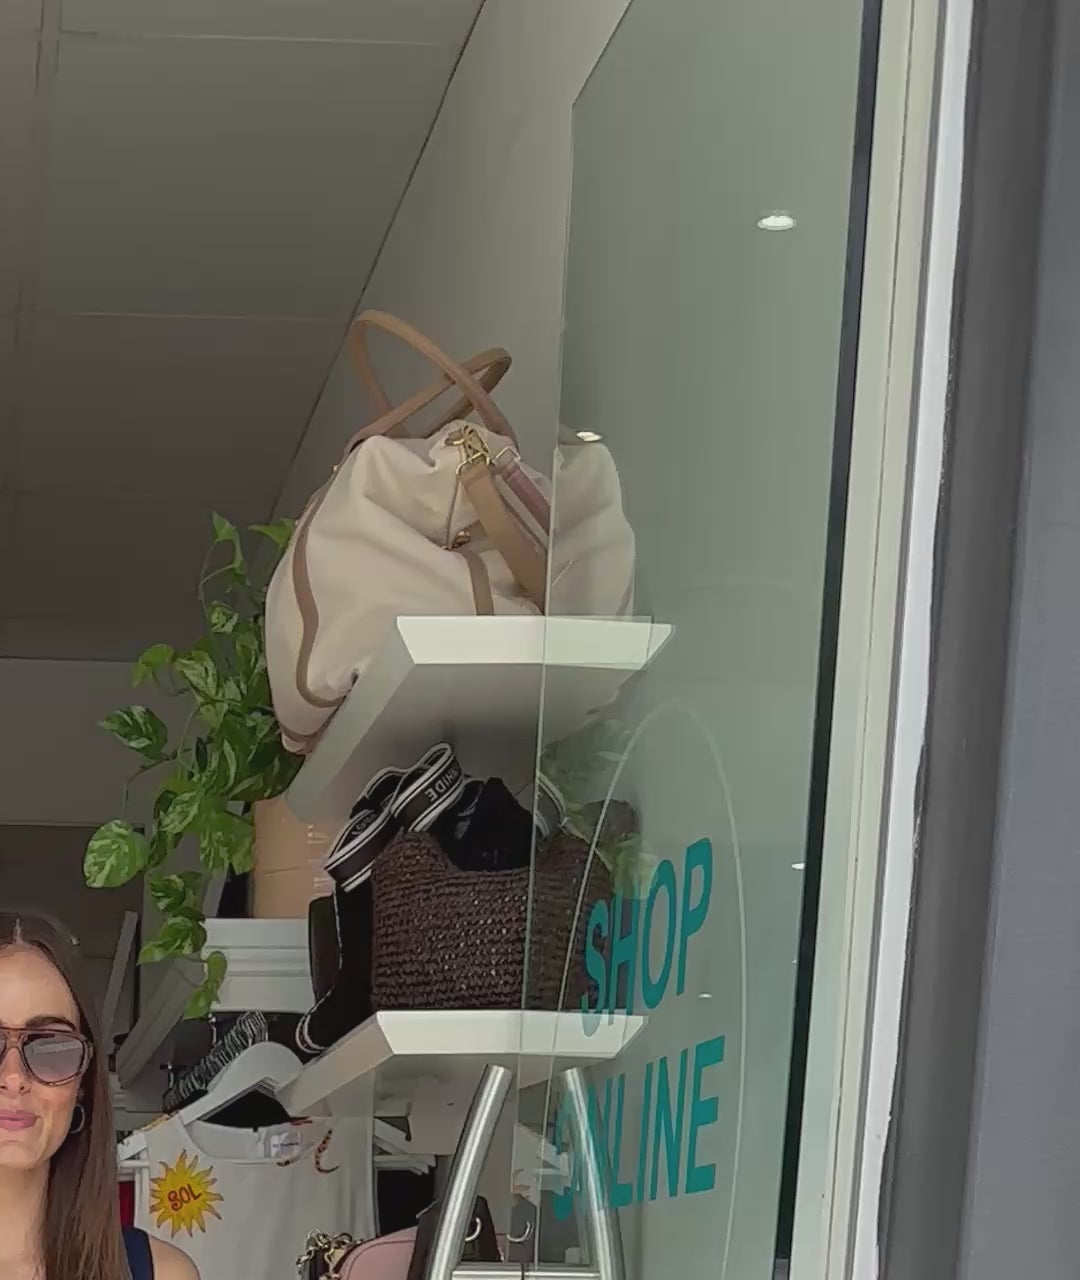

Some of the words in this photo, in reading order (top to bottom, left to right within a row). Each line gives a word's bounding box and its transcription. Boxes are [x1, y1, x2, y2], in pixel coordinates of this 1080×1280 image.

[581, 837, 713, 1027] SHOP
[168, 1183, 202, 1211] SOL
[551, 1034, 726, 1222] ONLINE
